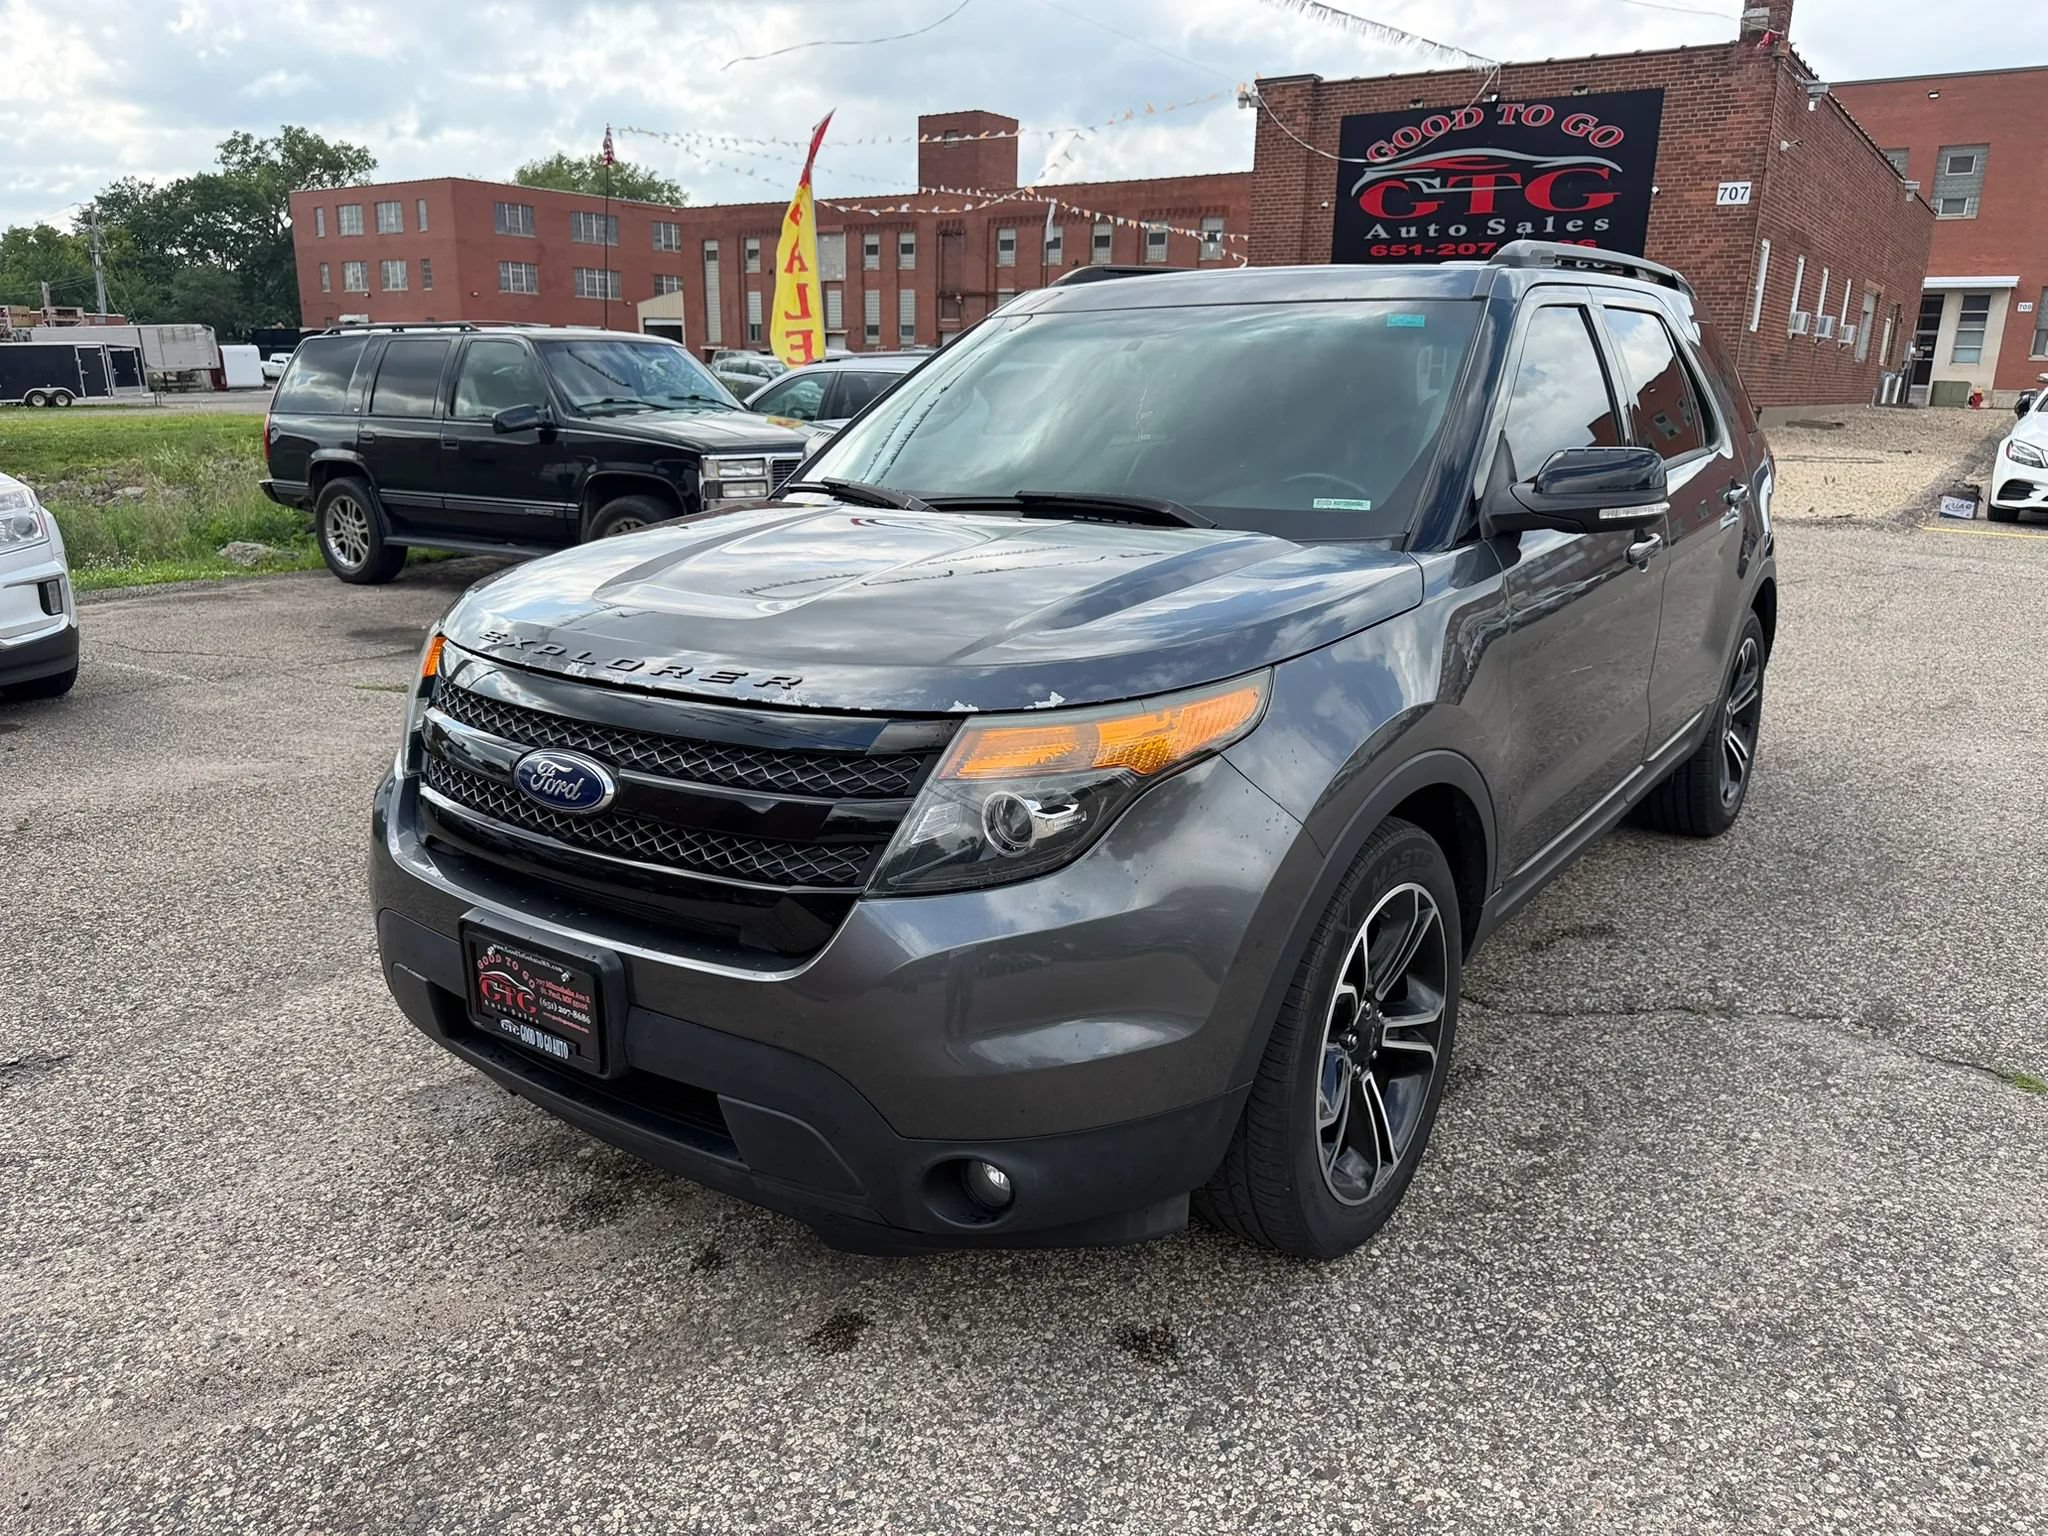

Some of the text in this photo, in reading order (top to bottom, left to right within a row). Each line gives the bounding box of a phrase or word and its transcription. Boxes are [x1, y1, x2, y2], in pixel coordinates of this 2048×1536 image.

[1366, 103, 1625, 162] GOOD TO GO
[1358, 167, 1622, 220] GTG
[1719, 186, 1750, 201] 707
[1363, 215, 1610, 240] Auto Sales
[479, 631, 804, 690] EXPLORER
[529, 760, 585, 801] Ford
[477, 953, 502, 970] GOOD
[505, 956, 519, 971] TO
[522, 970, 536, 989] GO
[520, 1024, 569, 1060] GOOD TO GO AUTO
